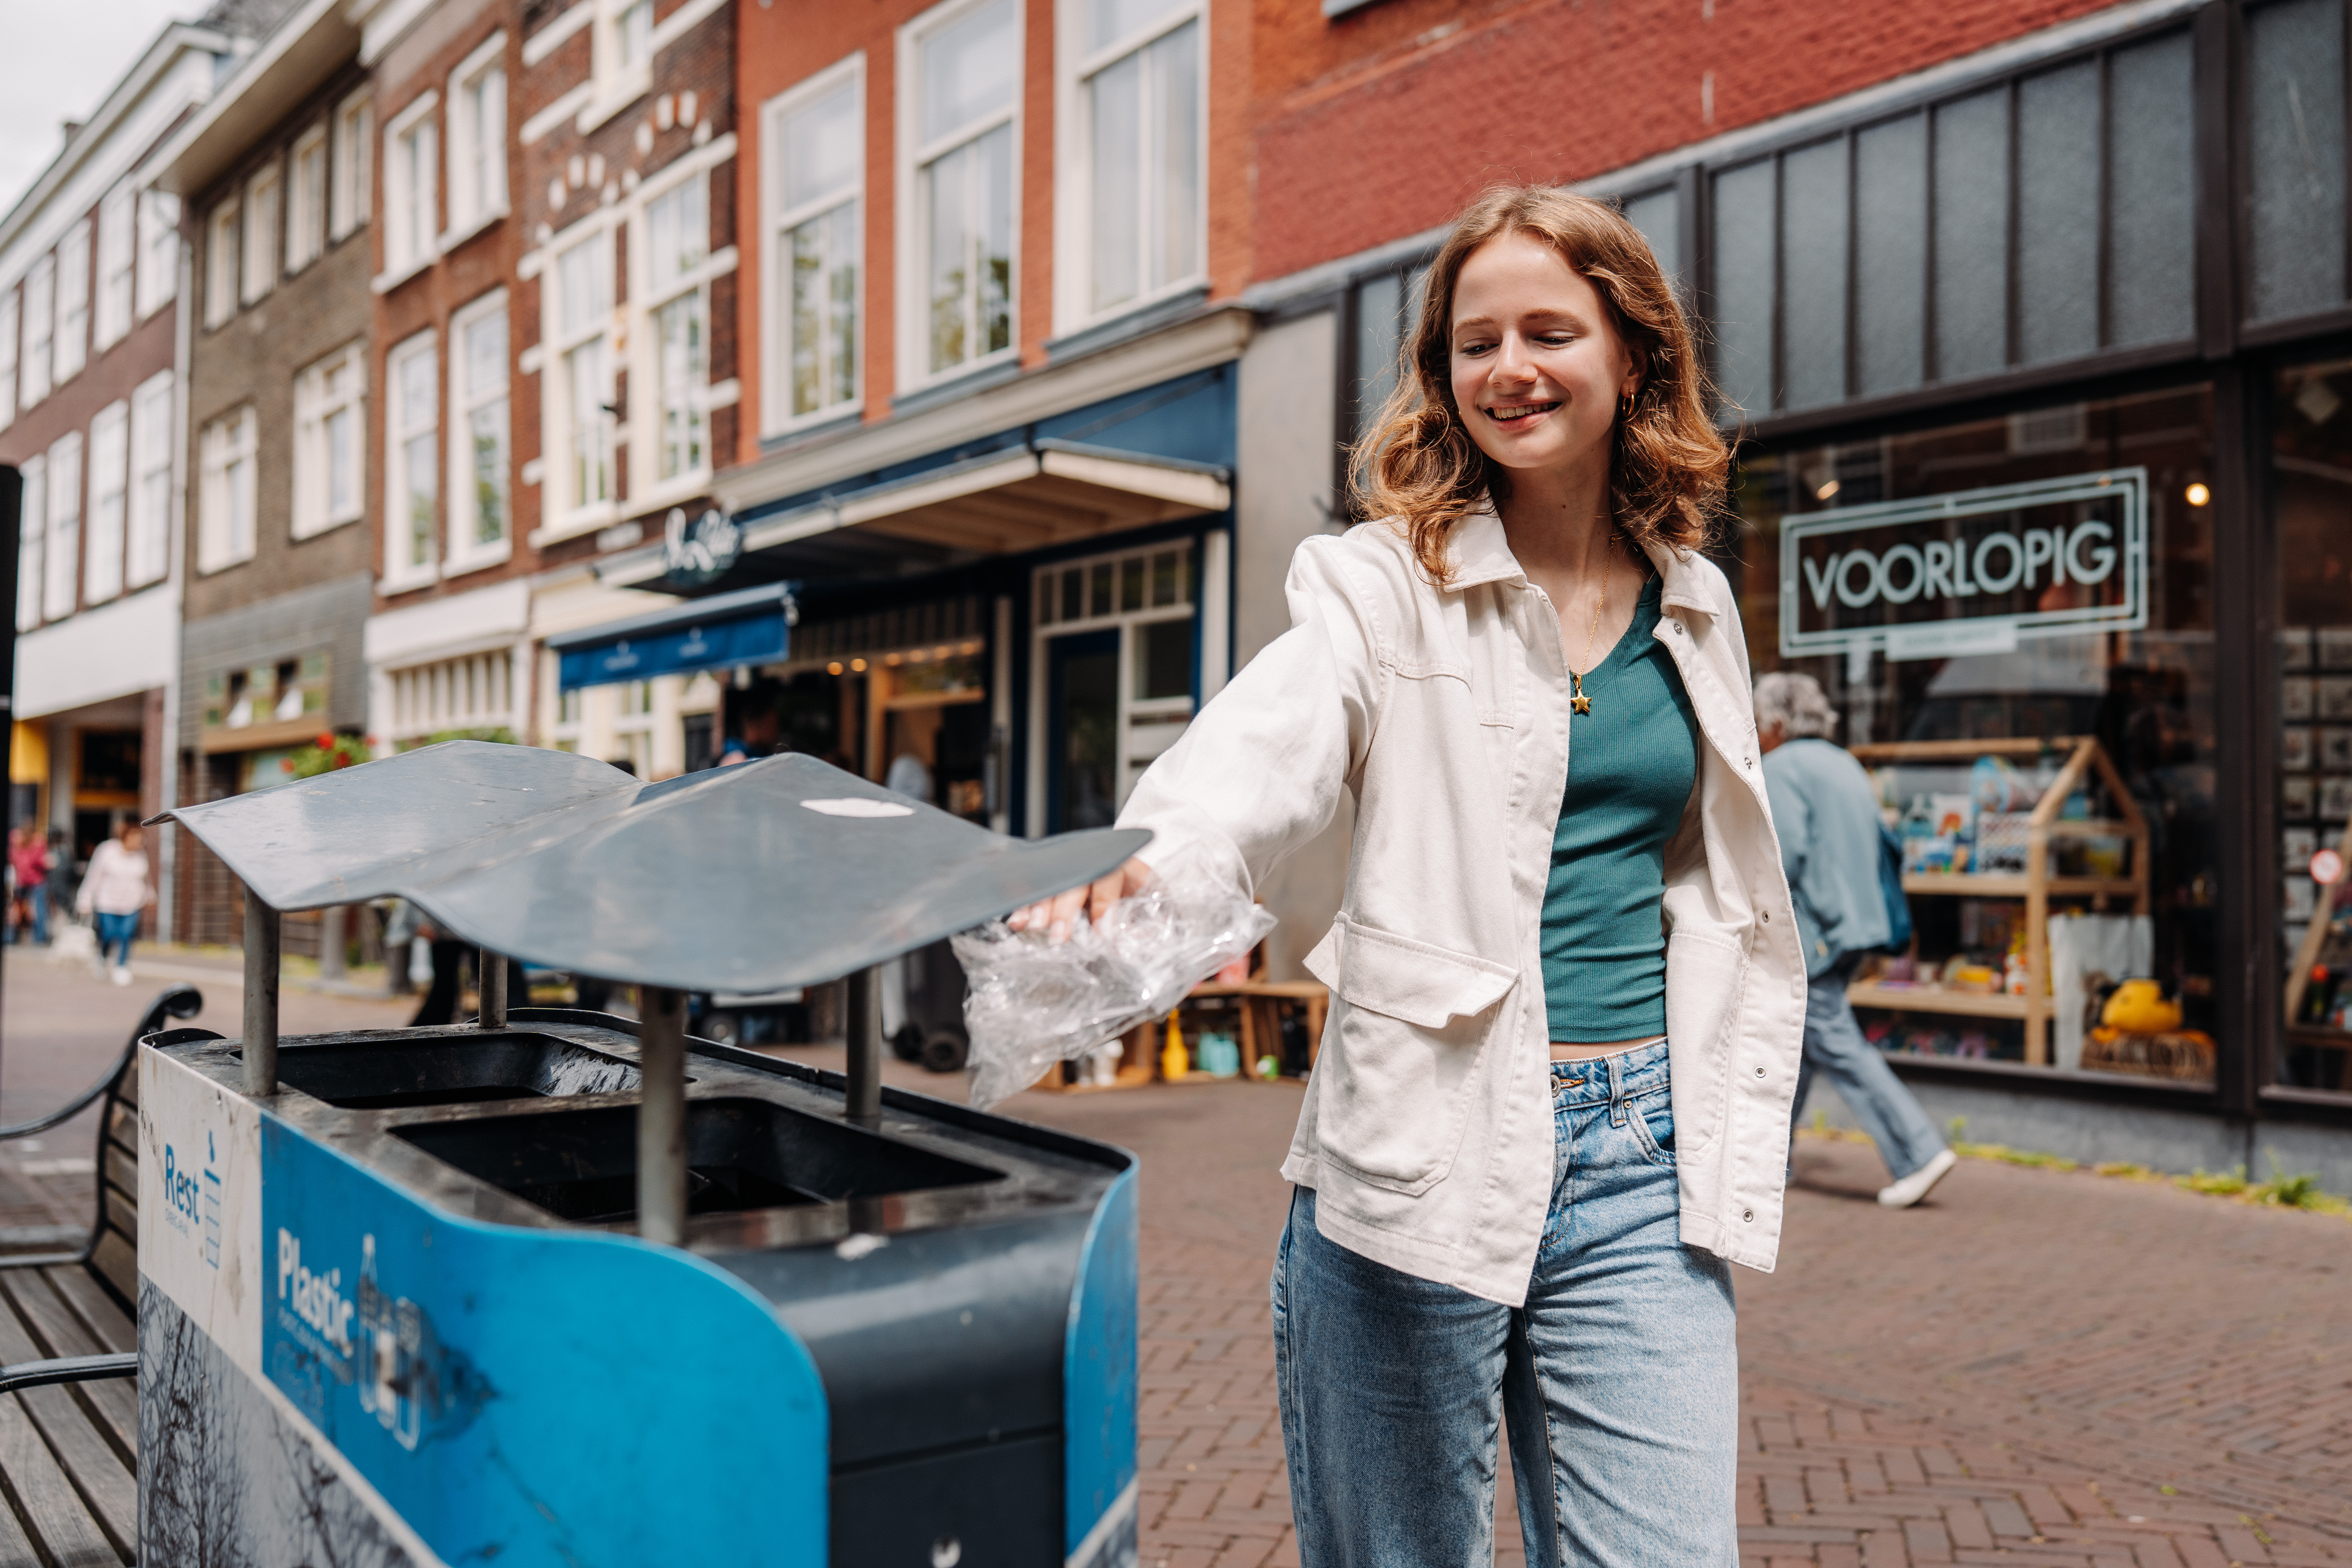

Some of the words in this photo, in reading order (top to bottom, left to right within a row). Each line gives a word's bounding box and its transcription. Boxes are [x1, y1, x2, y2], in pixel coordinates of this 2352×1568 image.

[1802, 520, 2118, 610] VOORLOPIG
[166, 1143, 199, 1225] Rest
[278, 1226, 354, 1359] Plastic
